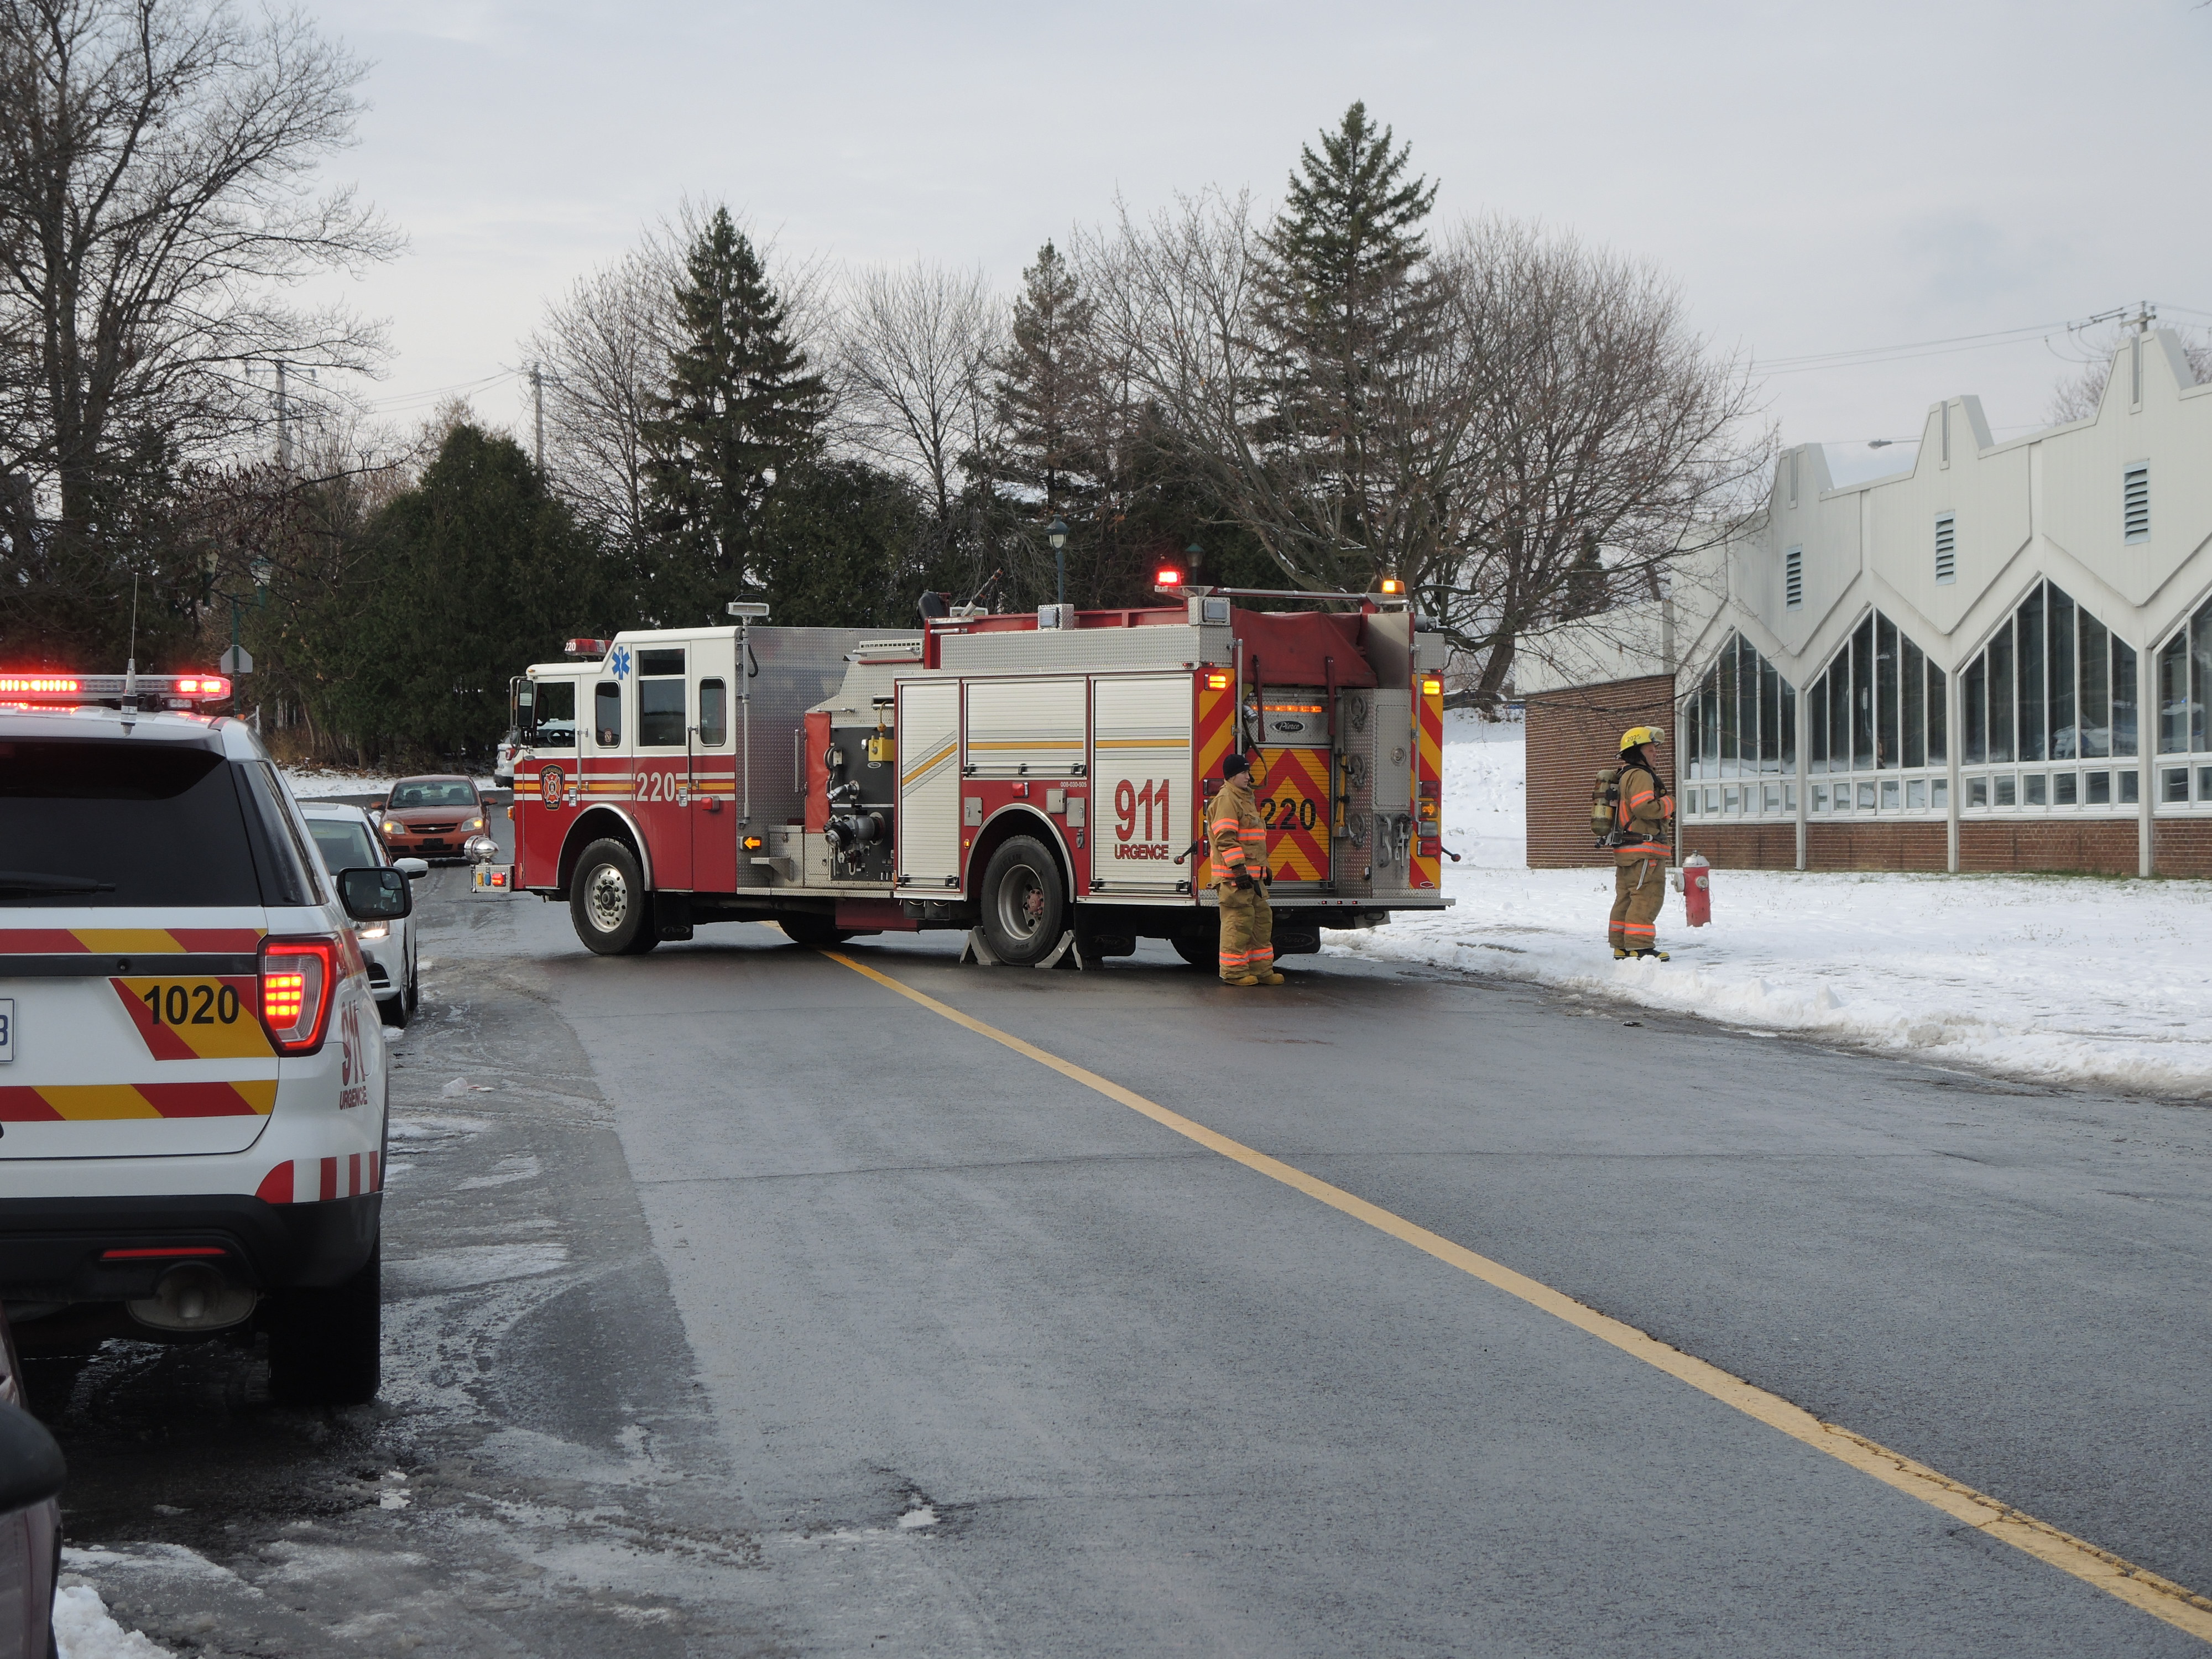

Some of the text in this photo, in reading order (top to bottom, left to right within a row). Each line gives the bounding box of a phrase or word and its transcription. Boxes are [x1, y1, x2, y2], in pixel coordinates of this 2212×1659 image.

[565, 642, 576, 651] 220
[637, 772, 675, 802] 220
[1115, 779, 1169, 842] 911
[1260, 798, 1316, 831] 220
[1114, 844, 1169, 859] URGENCE
[144, 985, 239, 1025] 1020
[341, 999, 366, 1087] 911
[339, 1086, 368, 1110] URGENCE
